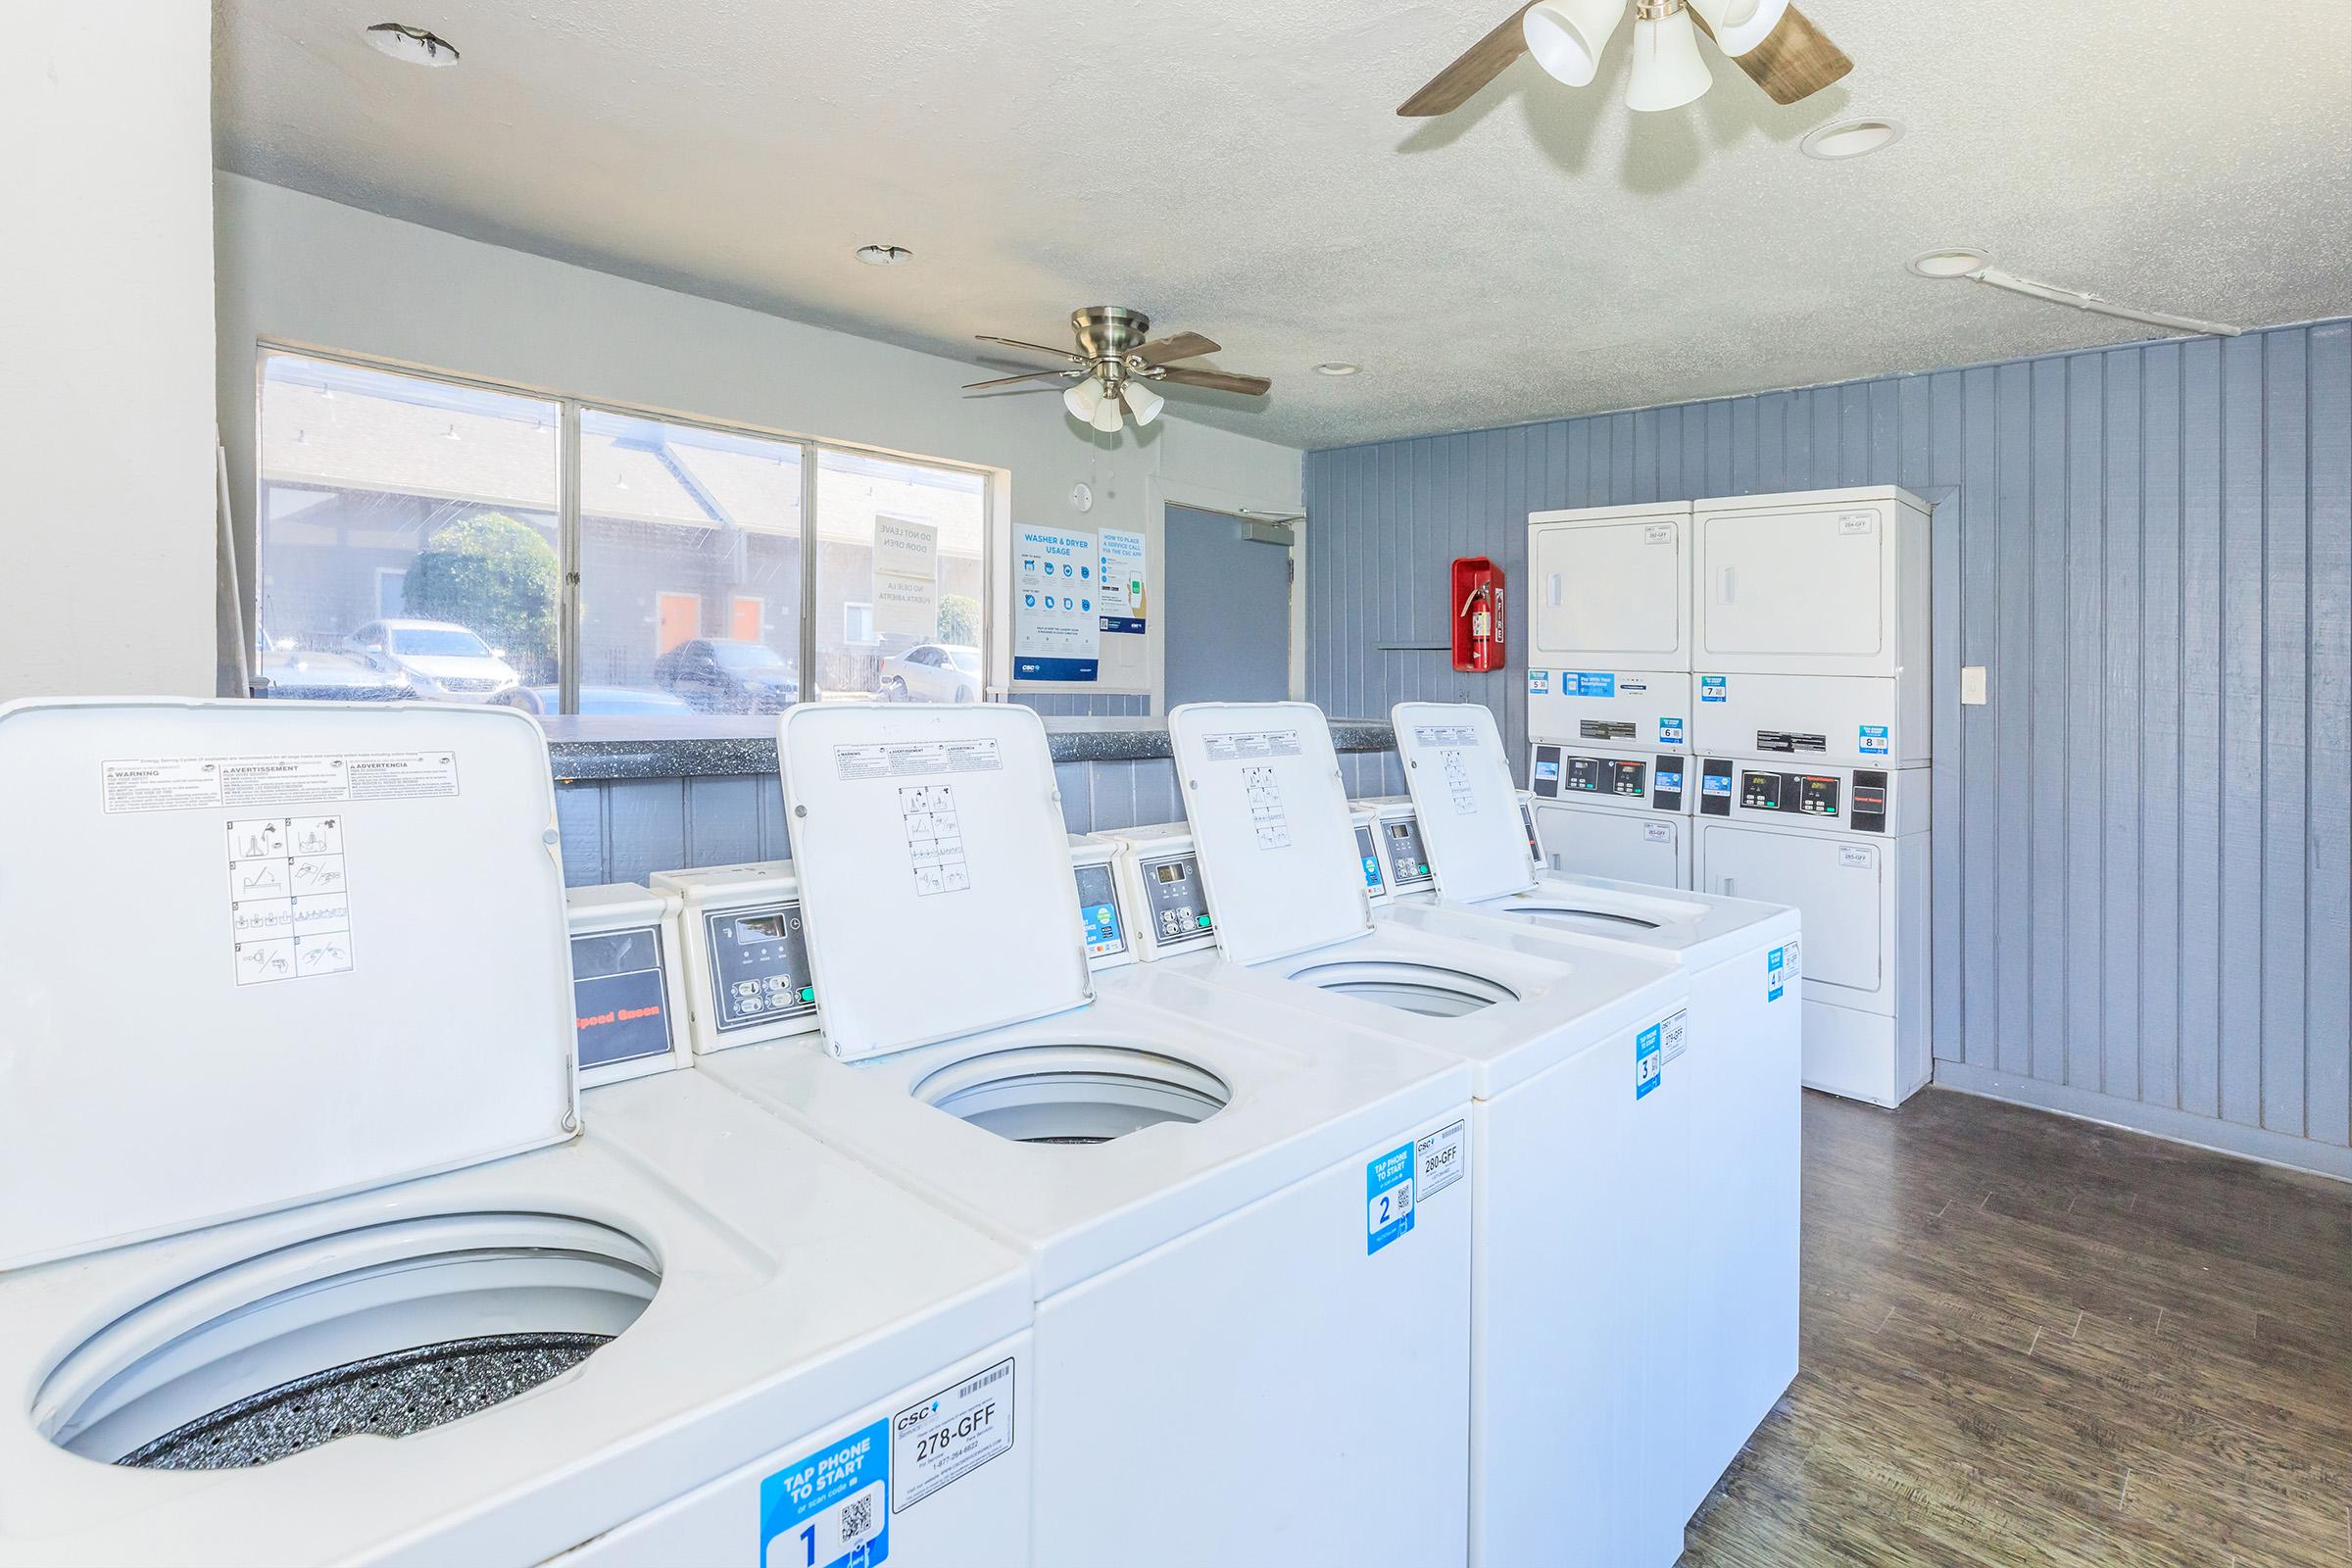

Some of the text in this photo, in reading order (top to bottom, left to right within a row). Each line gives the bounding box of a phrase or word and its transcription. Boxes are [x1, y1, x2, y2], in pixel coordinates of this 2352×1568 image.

[1024, 533, 1089, 549] WASHER & DRYER
[1046, 546, 1071, 556] USAGE
[1107, 541, 1128, 550] SERVICE
[230, 765, 299, 774] AVERTISSEMENT
[617, 1004, 660, 1021] Queen
[1642, 1059, 1648, 1079] 3
[1418, 1140, 1431, 1152] CSC
[1375, 1151, 1408, 1174] TAP PHONE
[1377, 1160, 1405, 1182] TO START
[1425, 1146, 1457, 1174] 280-GFF
[1379, 1196, 1391, 1225] 2
[898, 1406, 929, 1431] CSC
[916, 1401, 995, 1462] 278-GFF
[783, 1437, 870, 1493] TAP PHONE
[790, 1455, 864, 1503] TO START
[798, 1483, 847, 1514] or scan code
[800, 1524, 815, 1567] 1
